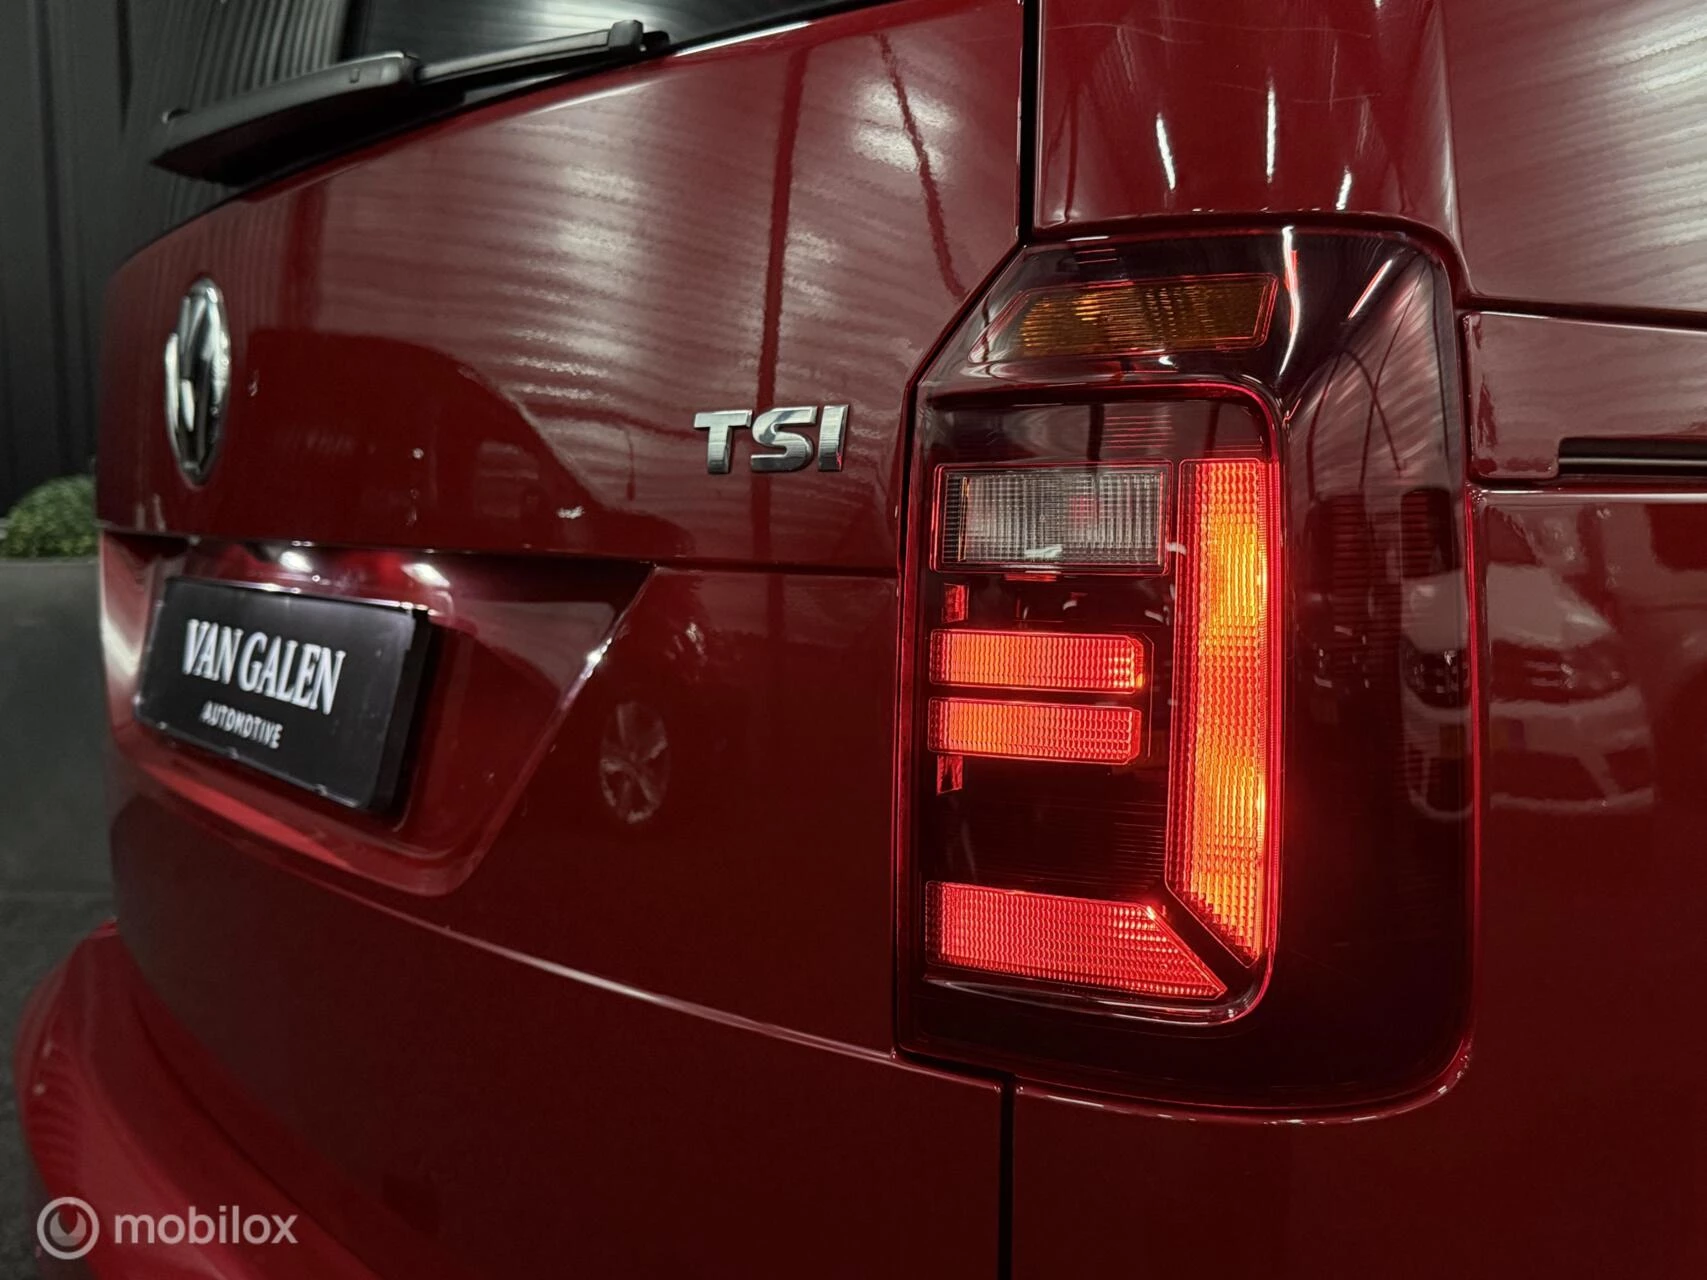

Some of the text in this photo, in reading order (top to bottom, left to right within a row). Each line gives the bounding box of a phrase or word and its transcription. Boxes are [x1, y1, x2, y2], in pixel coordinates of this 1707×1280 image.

[694, 404, 849, 474] TSI
[183, 619, 346, 715] VAN GALEN
[201, 701, 284, 749] AUTOMOTIVE
